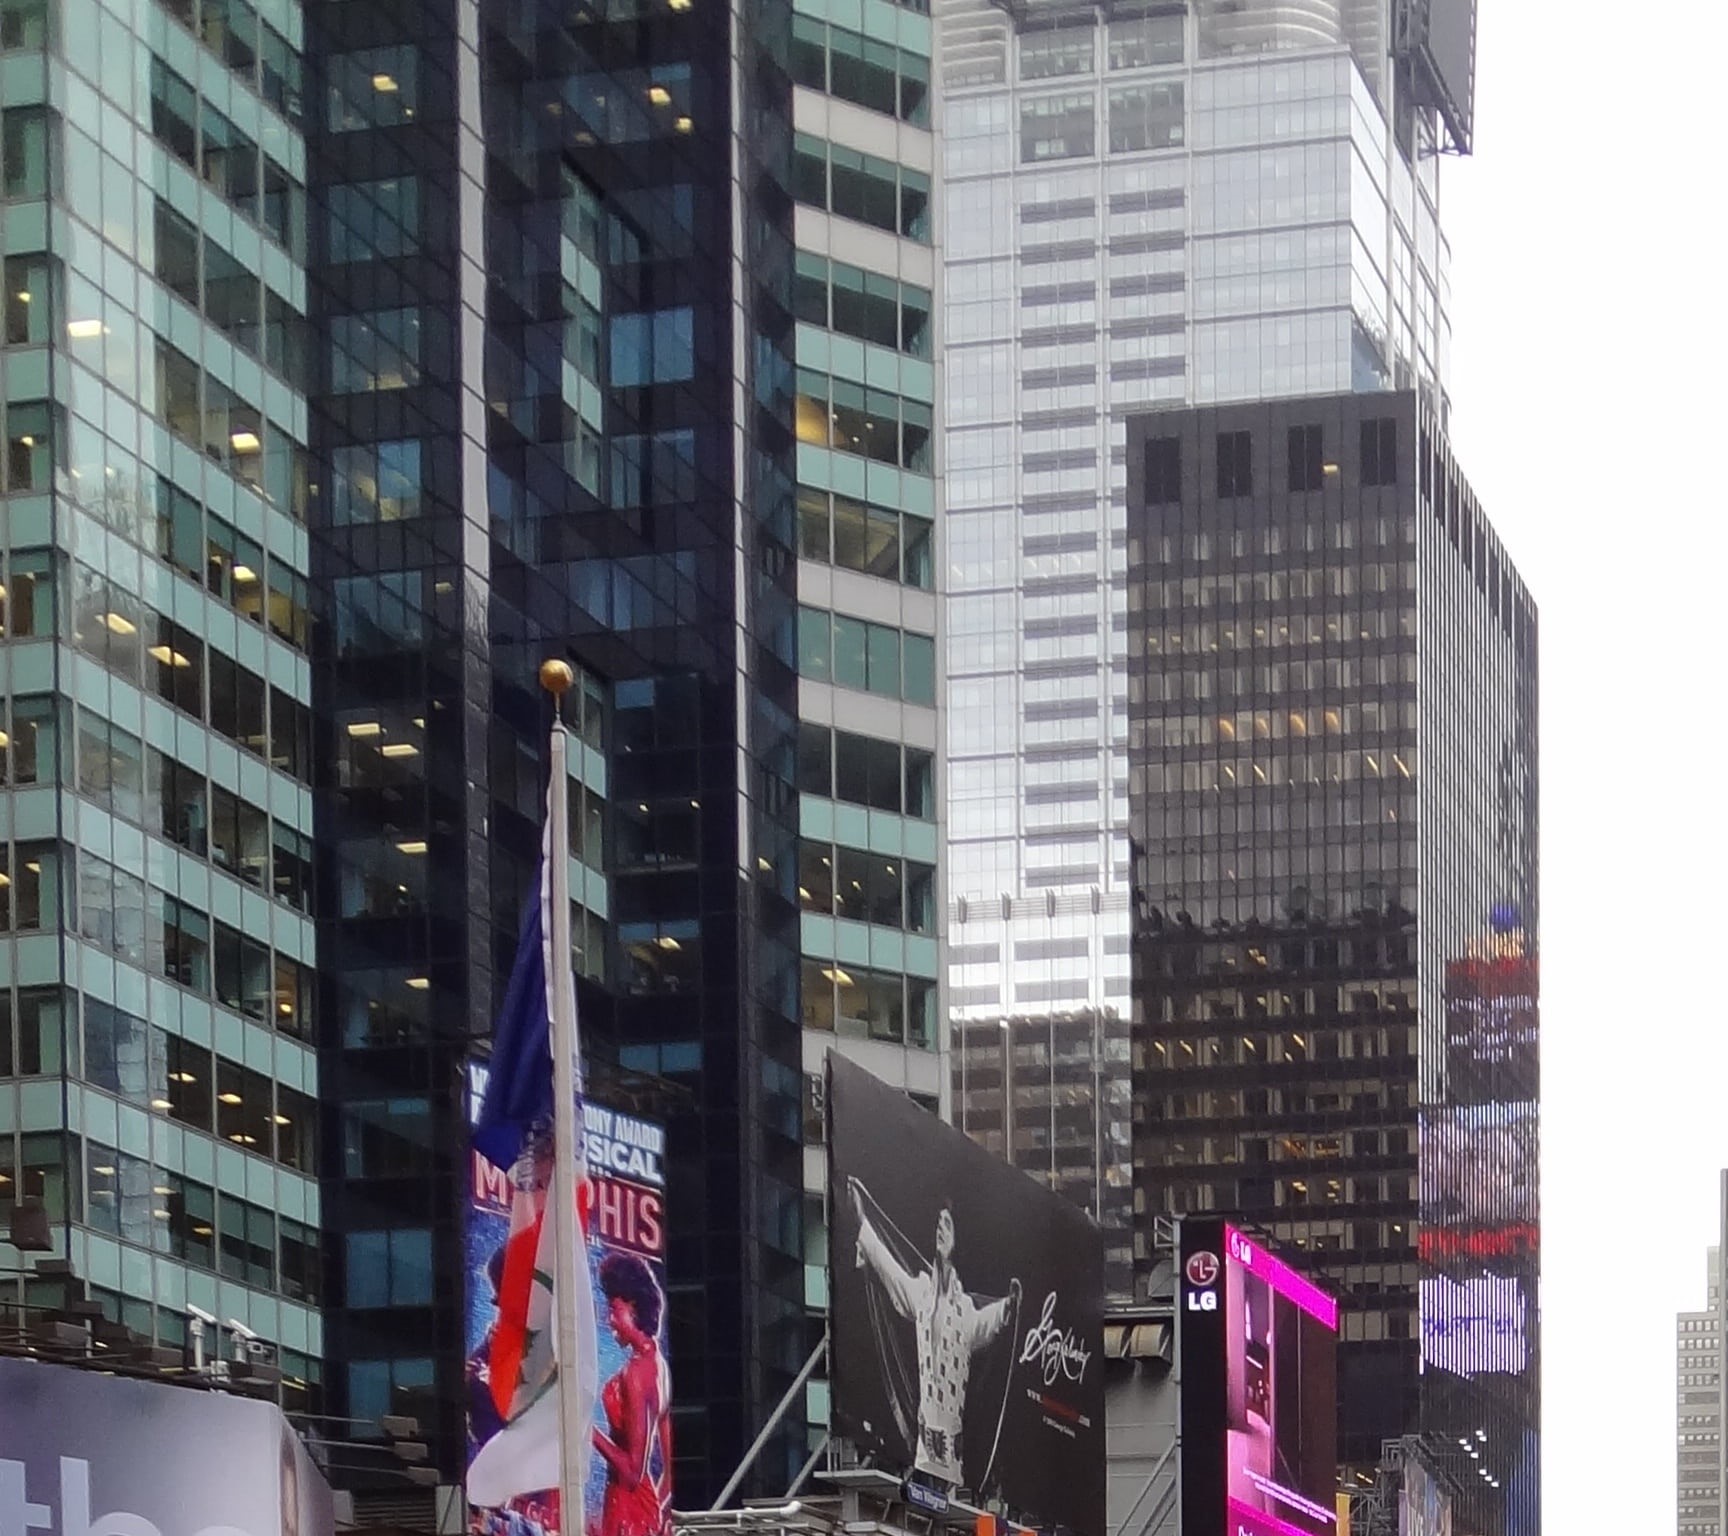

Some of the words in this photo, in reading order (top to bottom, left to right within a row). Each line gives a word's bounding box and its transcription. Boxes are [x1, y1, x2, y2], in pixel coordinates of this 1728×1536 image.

[582, 1103, 612, 1135] ONY
[582, 1130, 662, 1183] SICAL
[474, 1150, 662, 1250] MHIS
[1187, 1291, 1218, 1312] LG
